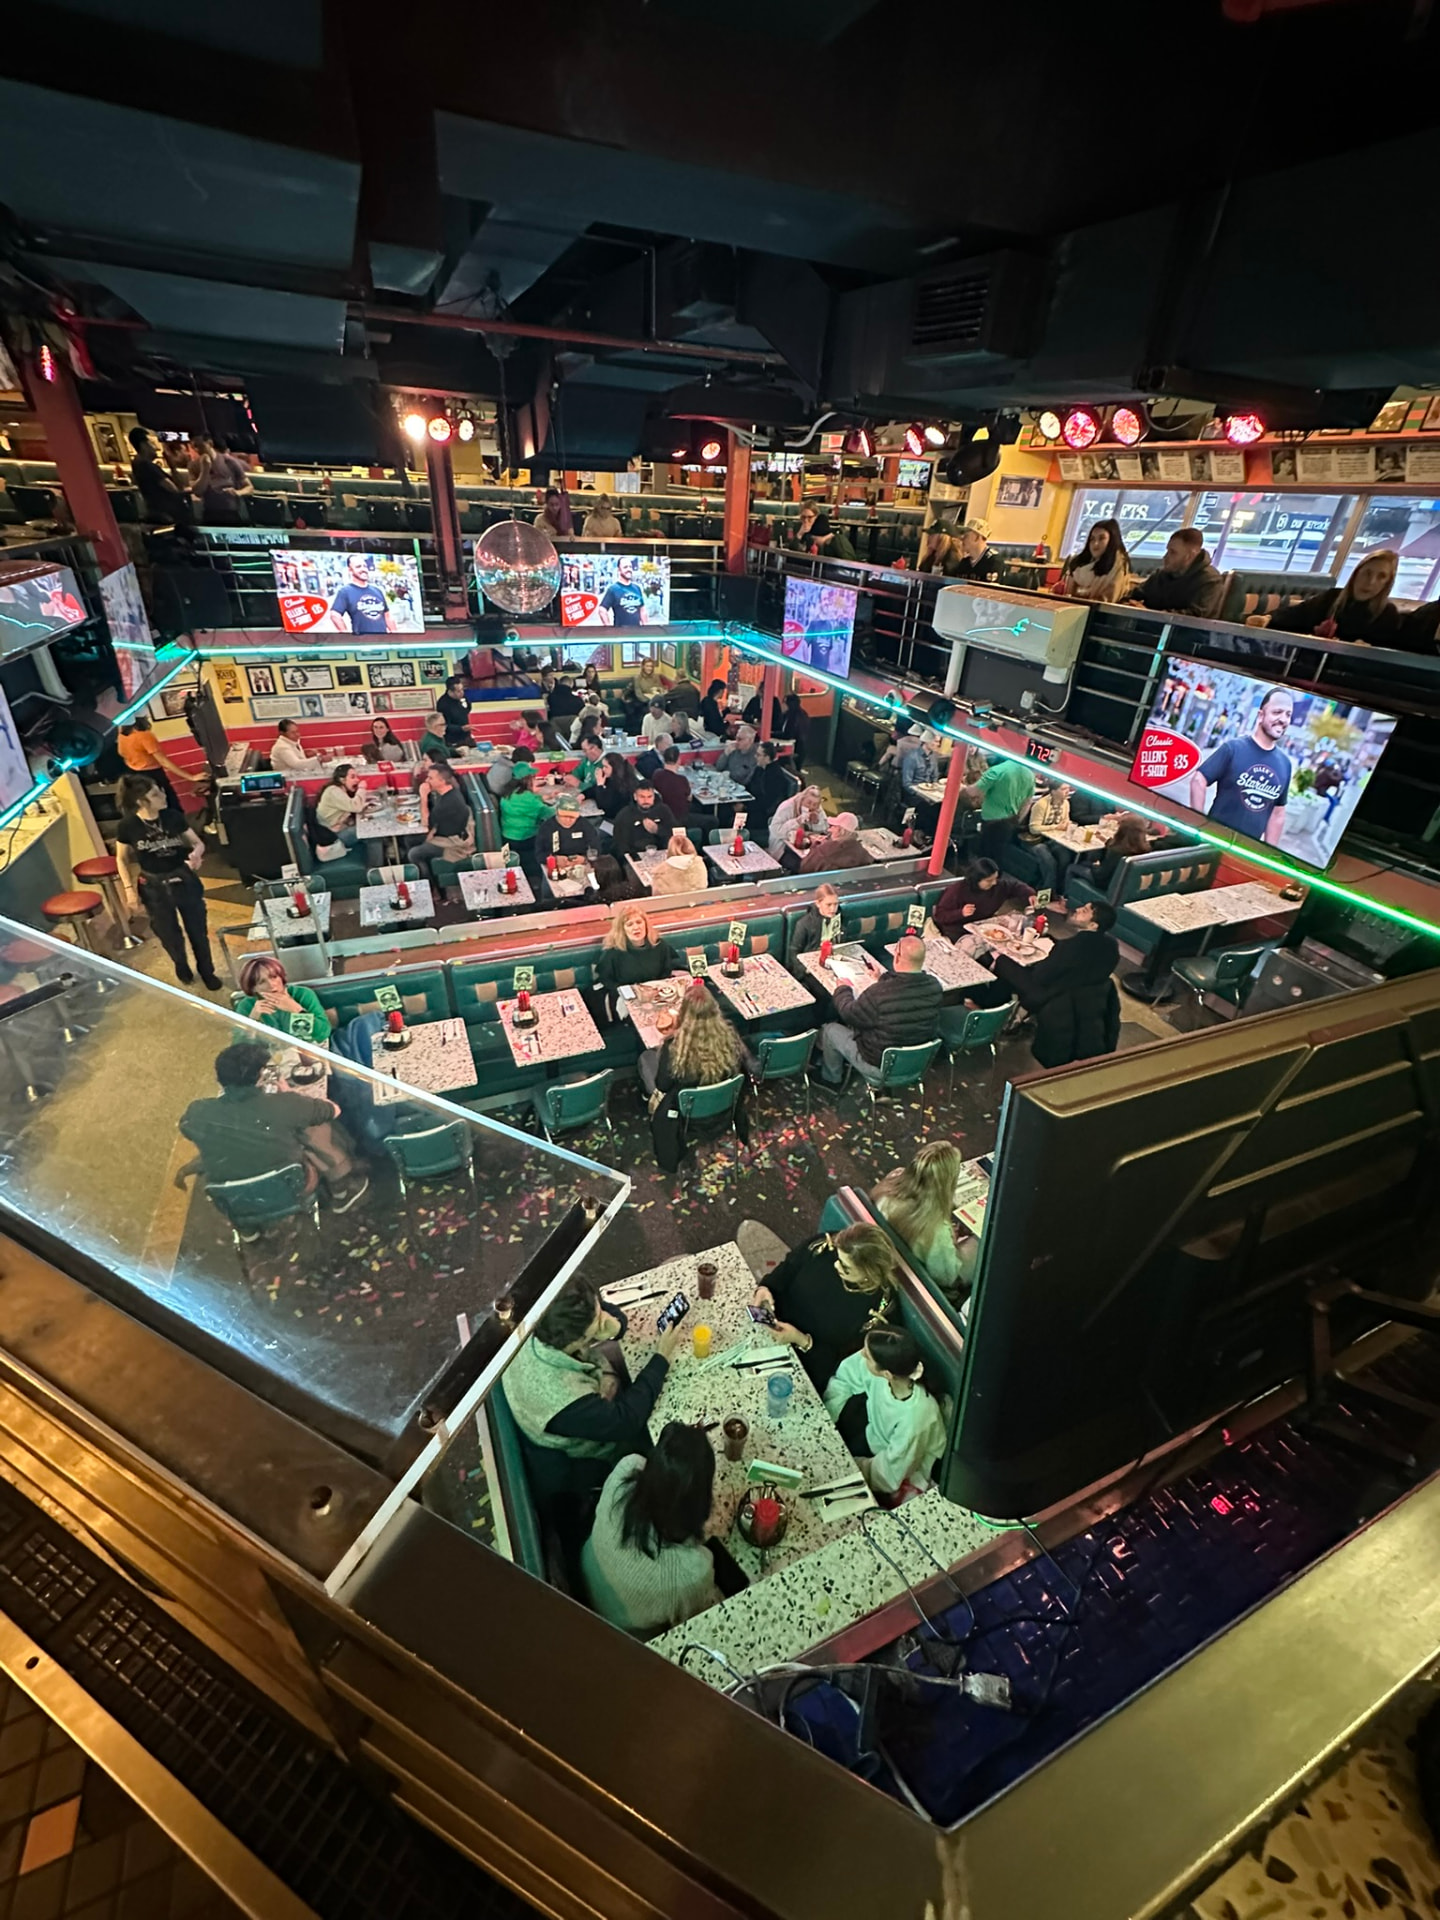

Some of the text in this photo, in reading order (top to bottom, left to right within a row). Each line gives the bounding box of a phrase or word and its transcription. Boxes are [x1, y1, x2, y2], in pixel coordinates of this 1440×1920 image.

[1100, 502, 1149, 519] GFTS
[1145, 735, 1173, 747] Classic
[1141, 750, 1168, 763] ELLEN'S
[1173, 754, 1189, 770] $35
[1140, 764, 1168, 777] T-SHIRT
[1236, 772, 1281, 796] Stardust
